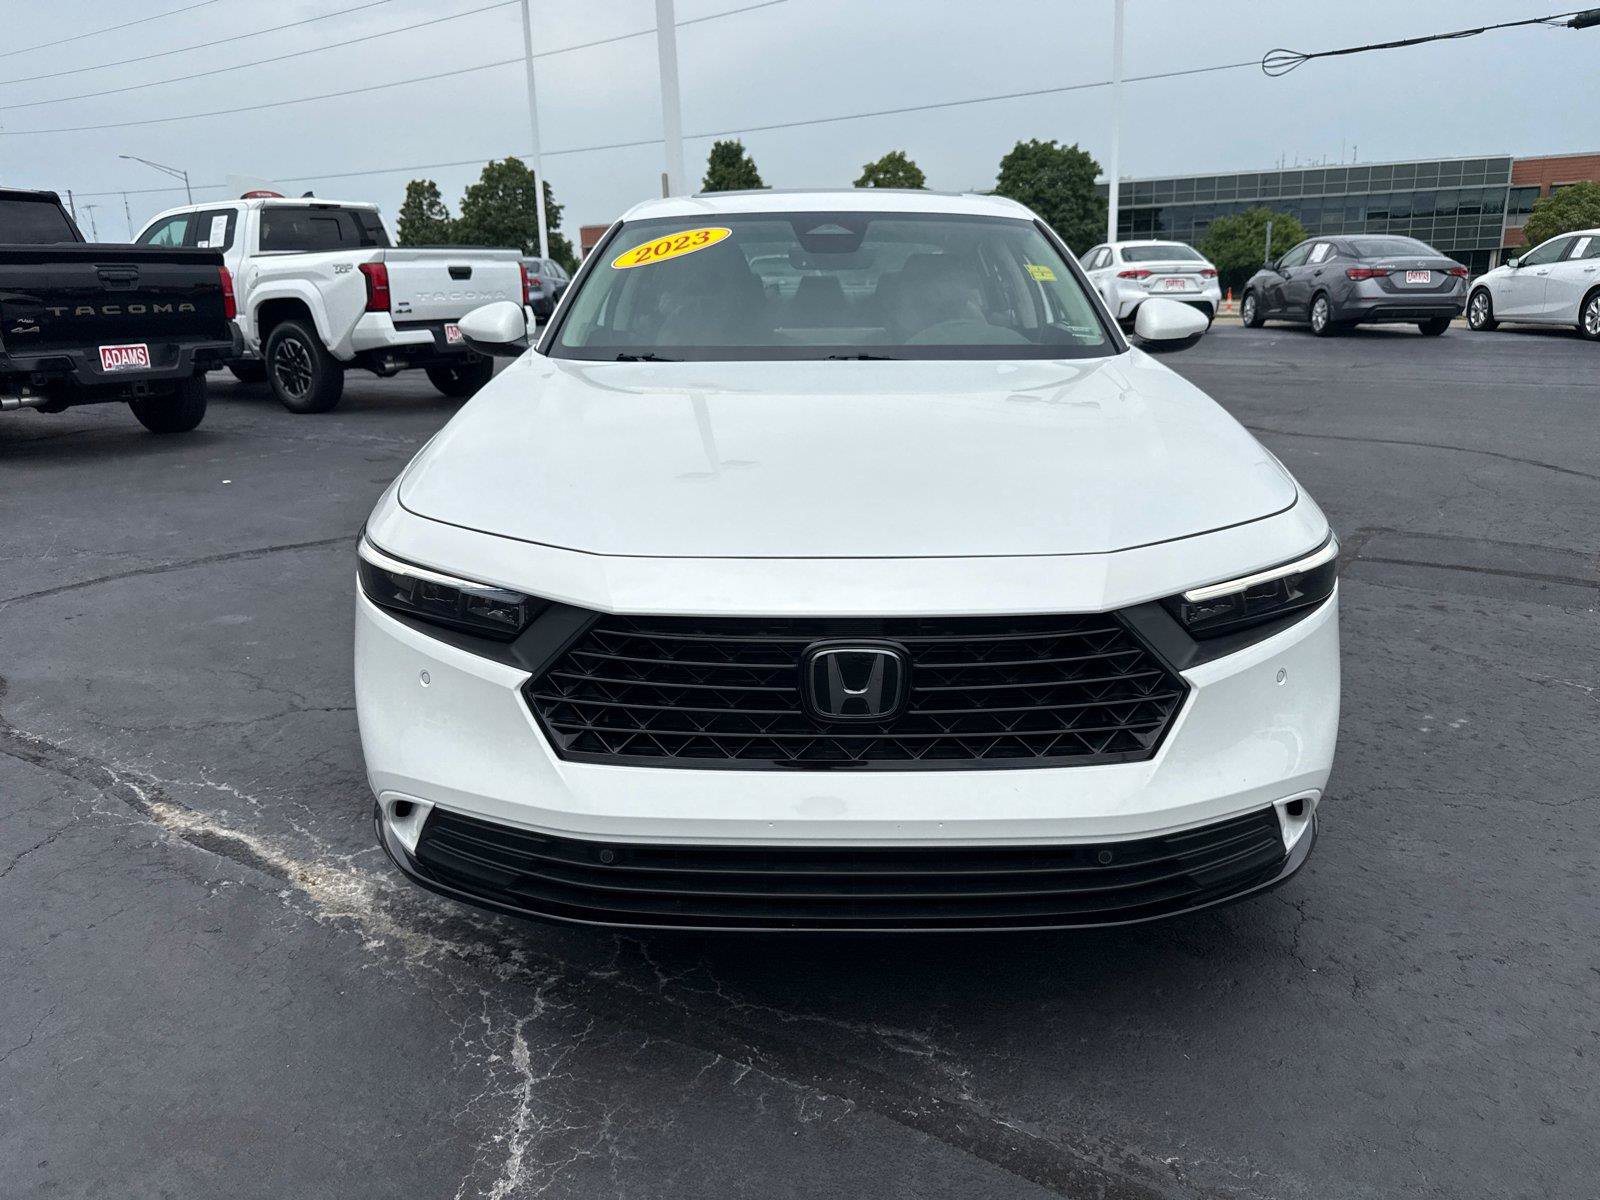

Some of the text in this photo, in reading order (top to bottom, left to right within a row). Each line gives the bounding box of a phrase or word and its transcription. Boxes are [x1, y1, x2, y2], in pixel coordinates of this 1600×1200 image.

[634, 231, 711, 264] 2023
[415, 291, 507, 301] TACOMA
[45, 303, 196, 317] TACOMA
[104, 348, 147, 369] ADAMS
